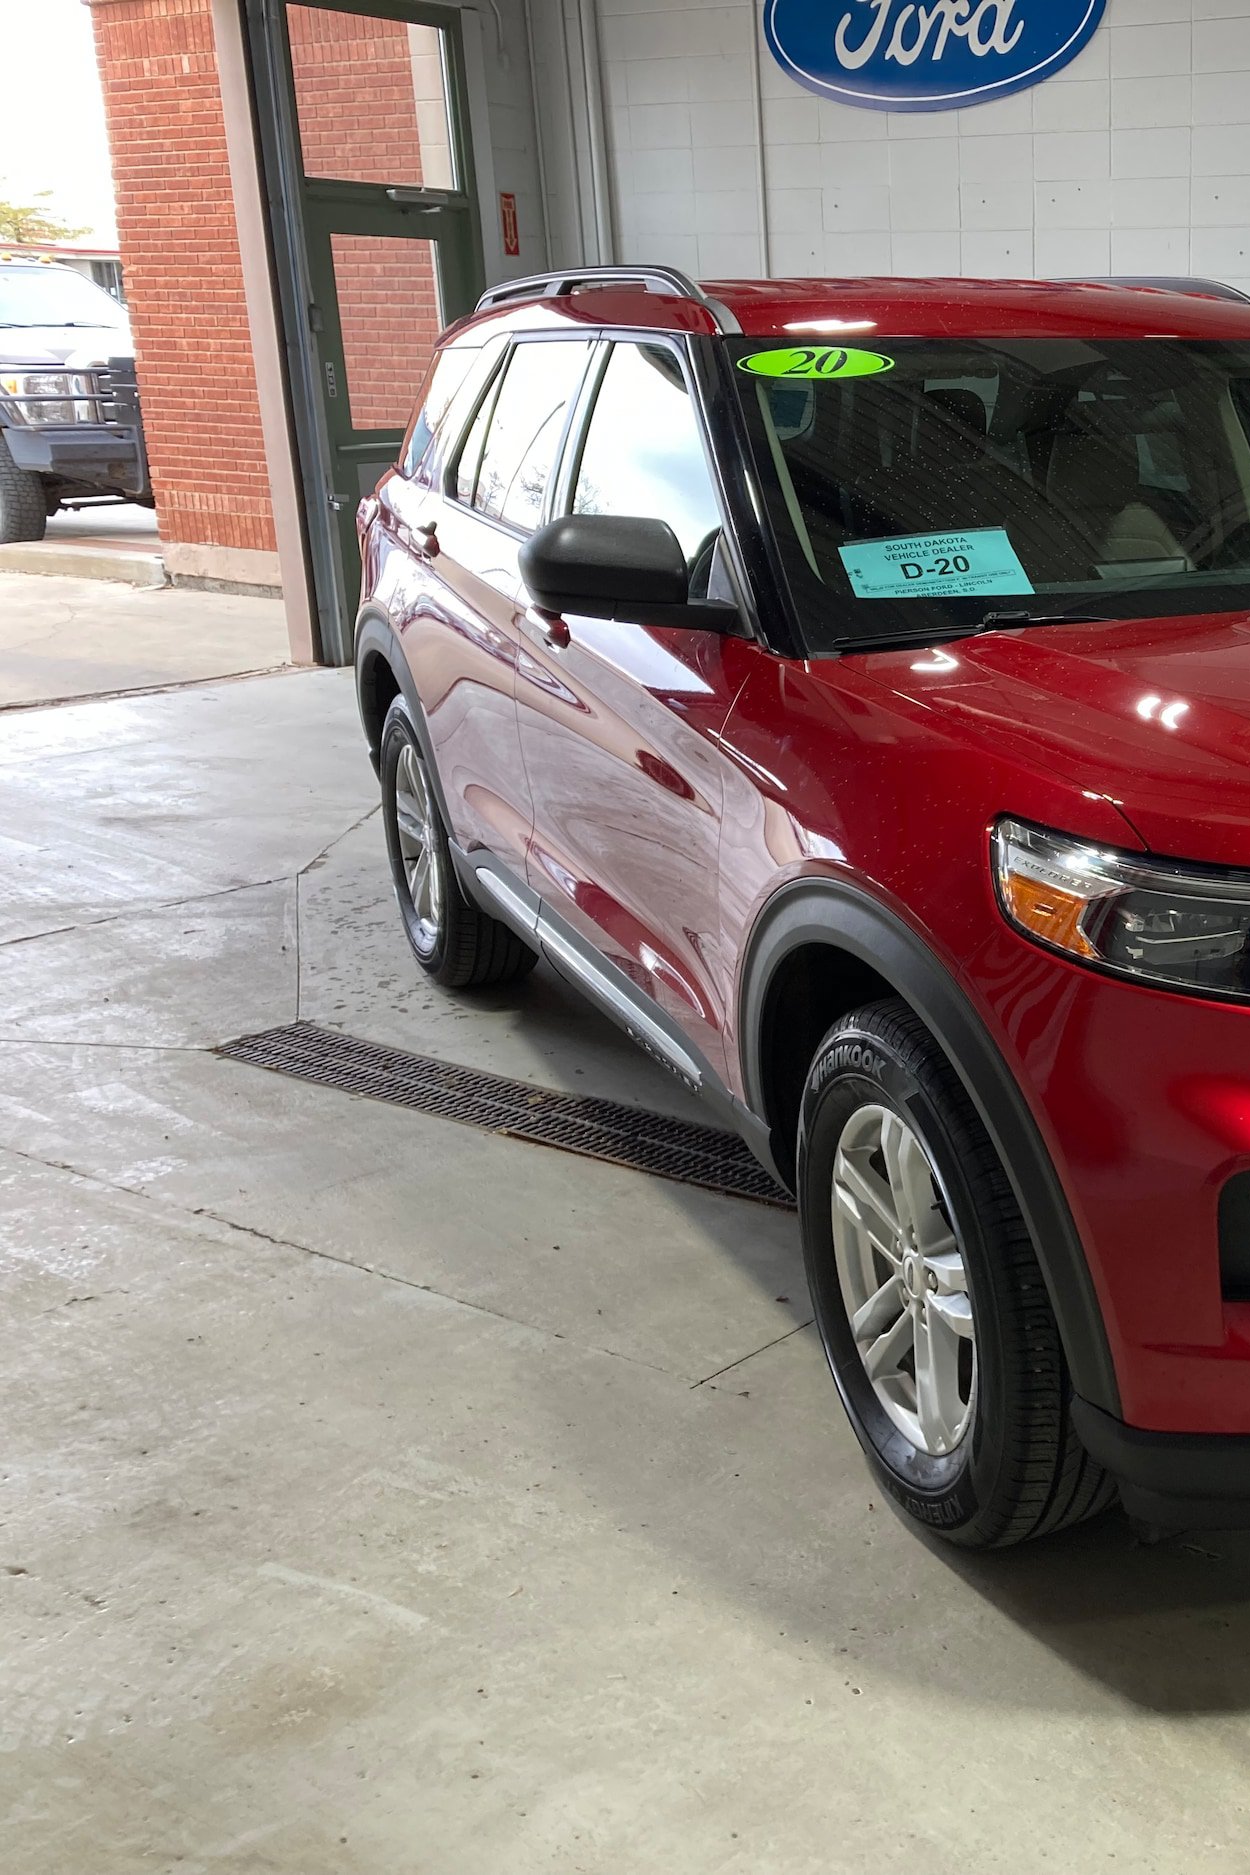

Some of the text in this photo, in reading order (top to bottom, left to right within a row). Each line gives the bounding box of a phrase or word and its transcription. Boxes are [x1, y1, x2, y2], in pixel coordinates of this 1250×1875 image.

[782, 350, 848, 375] 20
[884, 544, 974, 562] VEHICLE DEALER
[885, 537, 967, 552] SOUTH DAKOTA
[900, 555, 971, 580] D-20
[895, 587, 930, 595] PIERSON
[958, 579, 993, 588] LINCOLN
